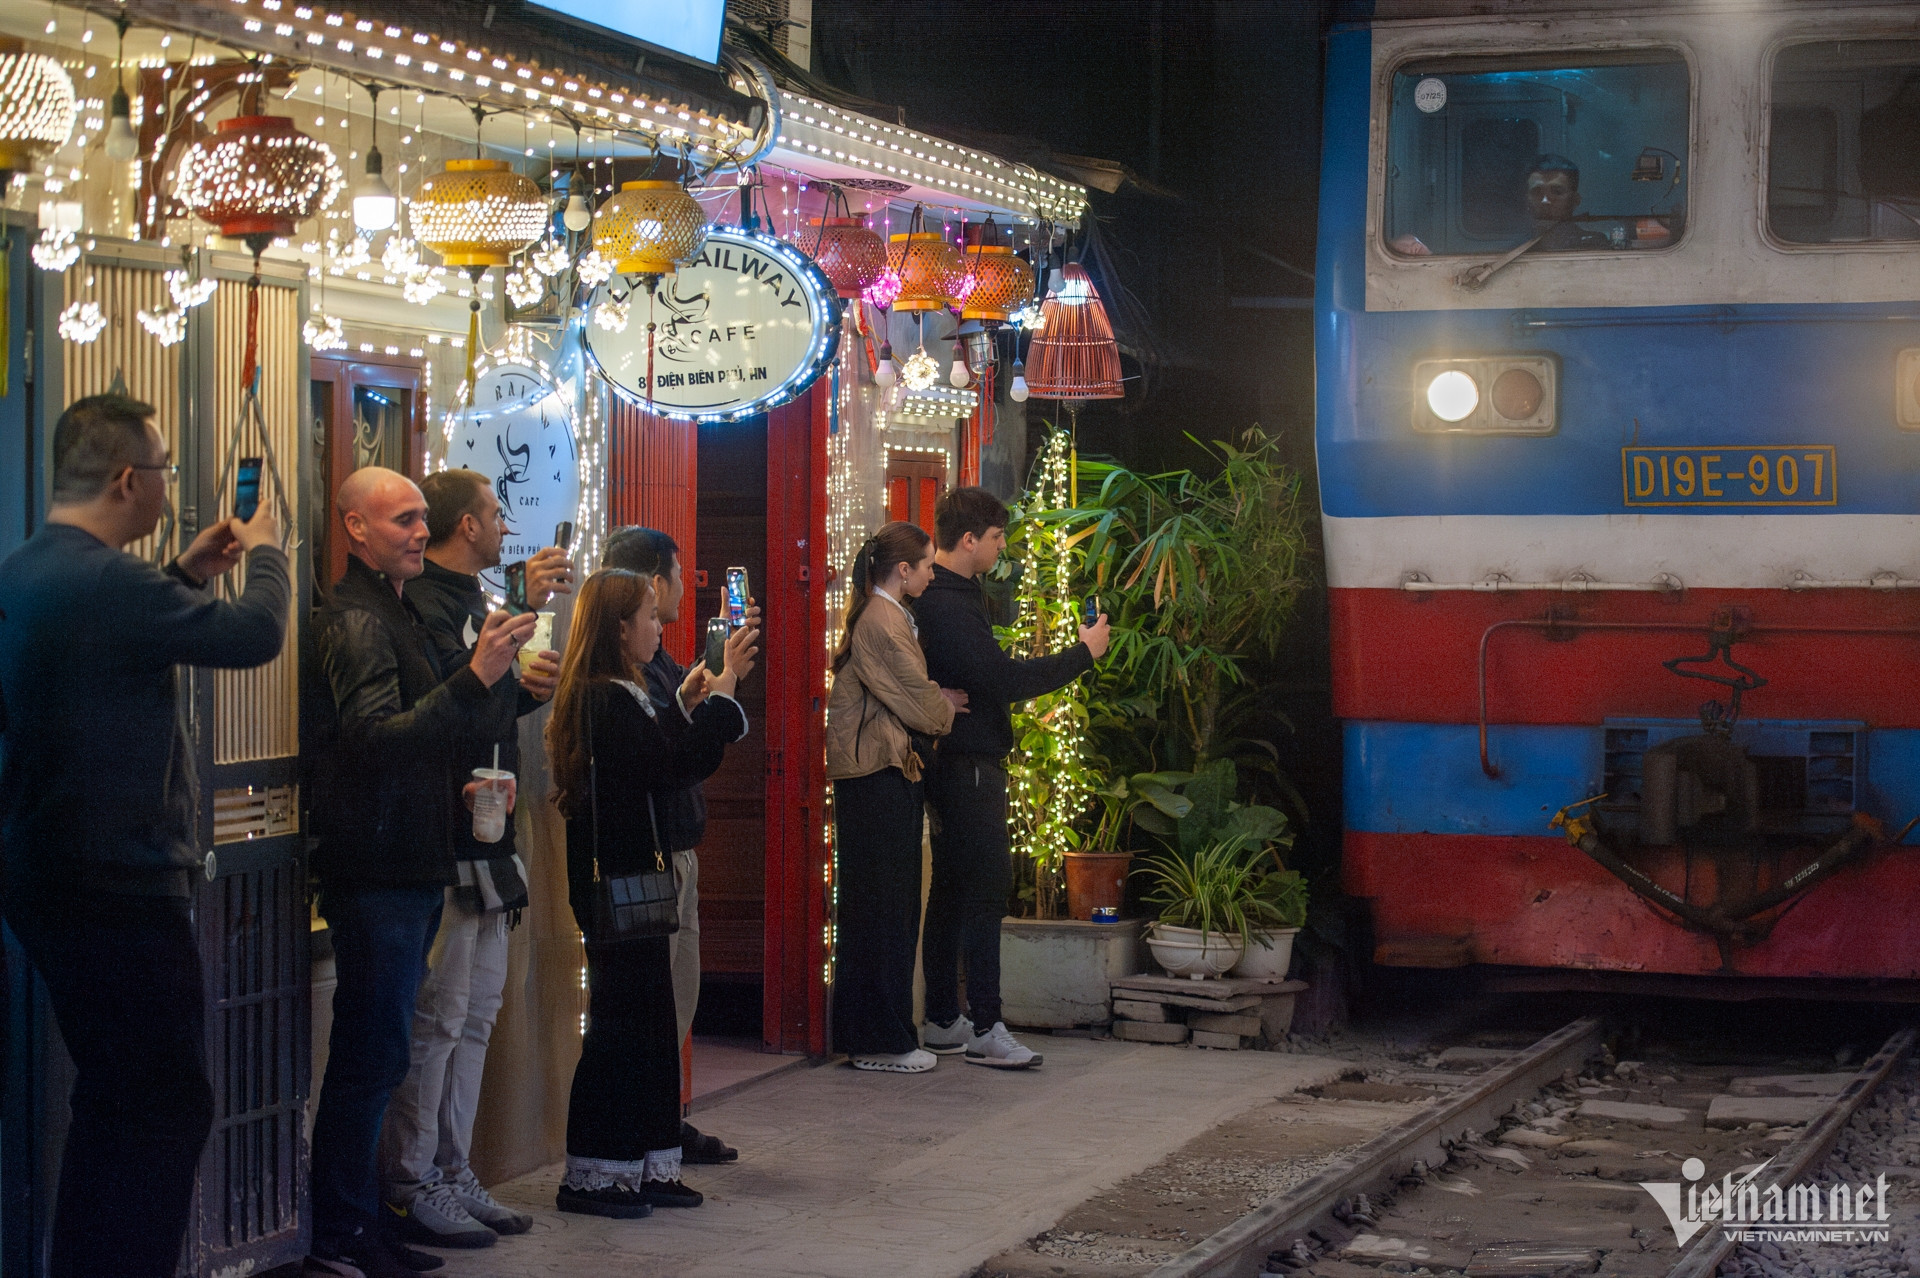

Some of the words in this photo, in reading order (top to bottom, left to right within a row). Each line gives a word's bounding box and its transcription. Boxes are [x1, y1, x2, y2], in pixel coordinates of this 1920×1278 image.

[685, 247, 802, 310] AILWAY
[690, 324, 756, 345] CAFE
[657, 371, 684, 390] ĐIỆN
[688, 369, 715, 385] BIÊN
[750, 366, 768, 381] HN
[1633, 454, 1823, 497] D19E-907
[508, 544, 525, 555] BIÊN
